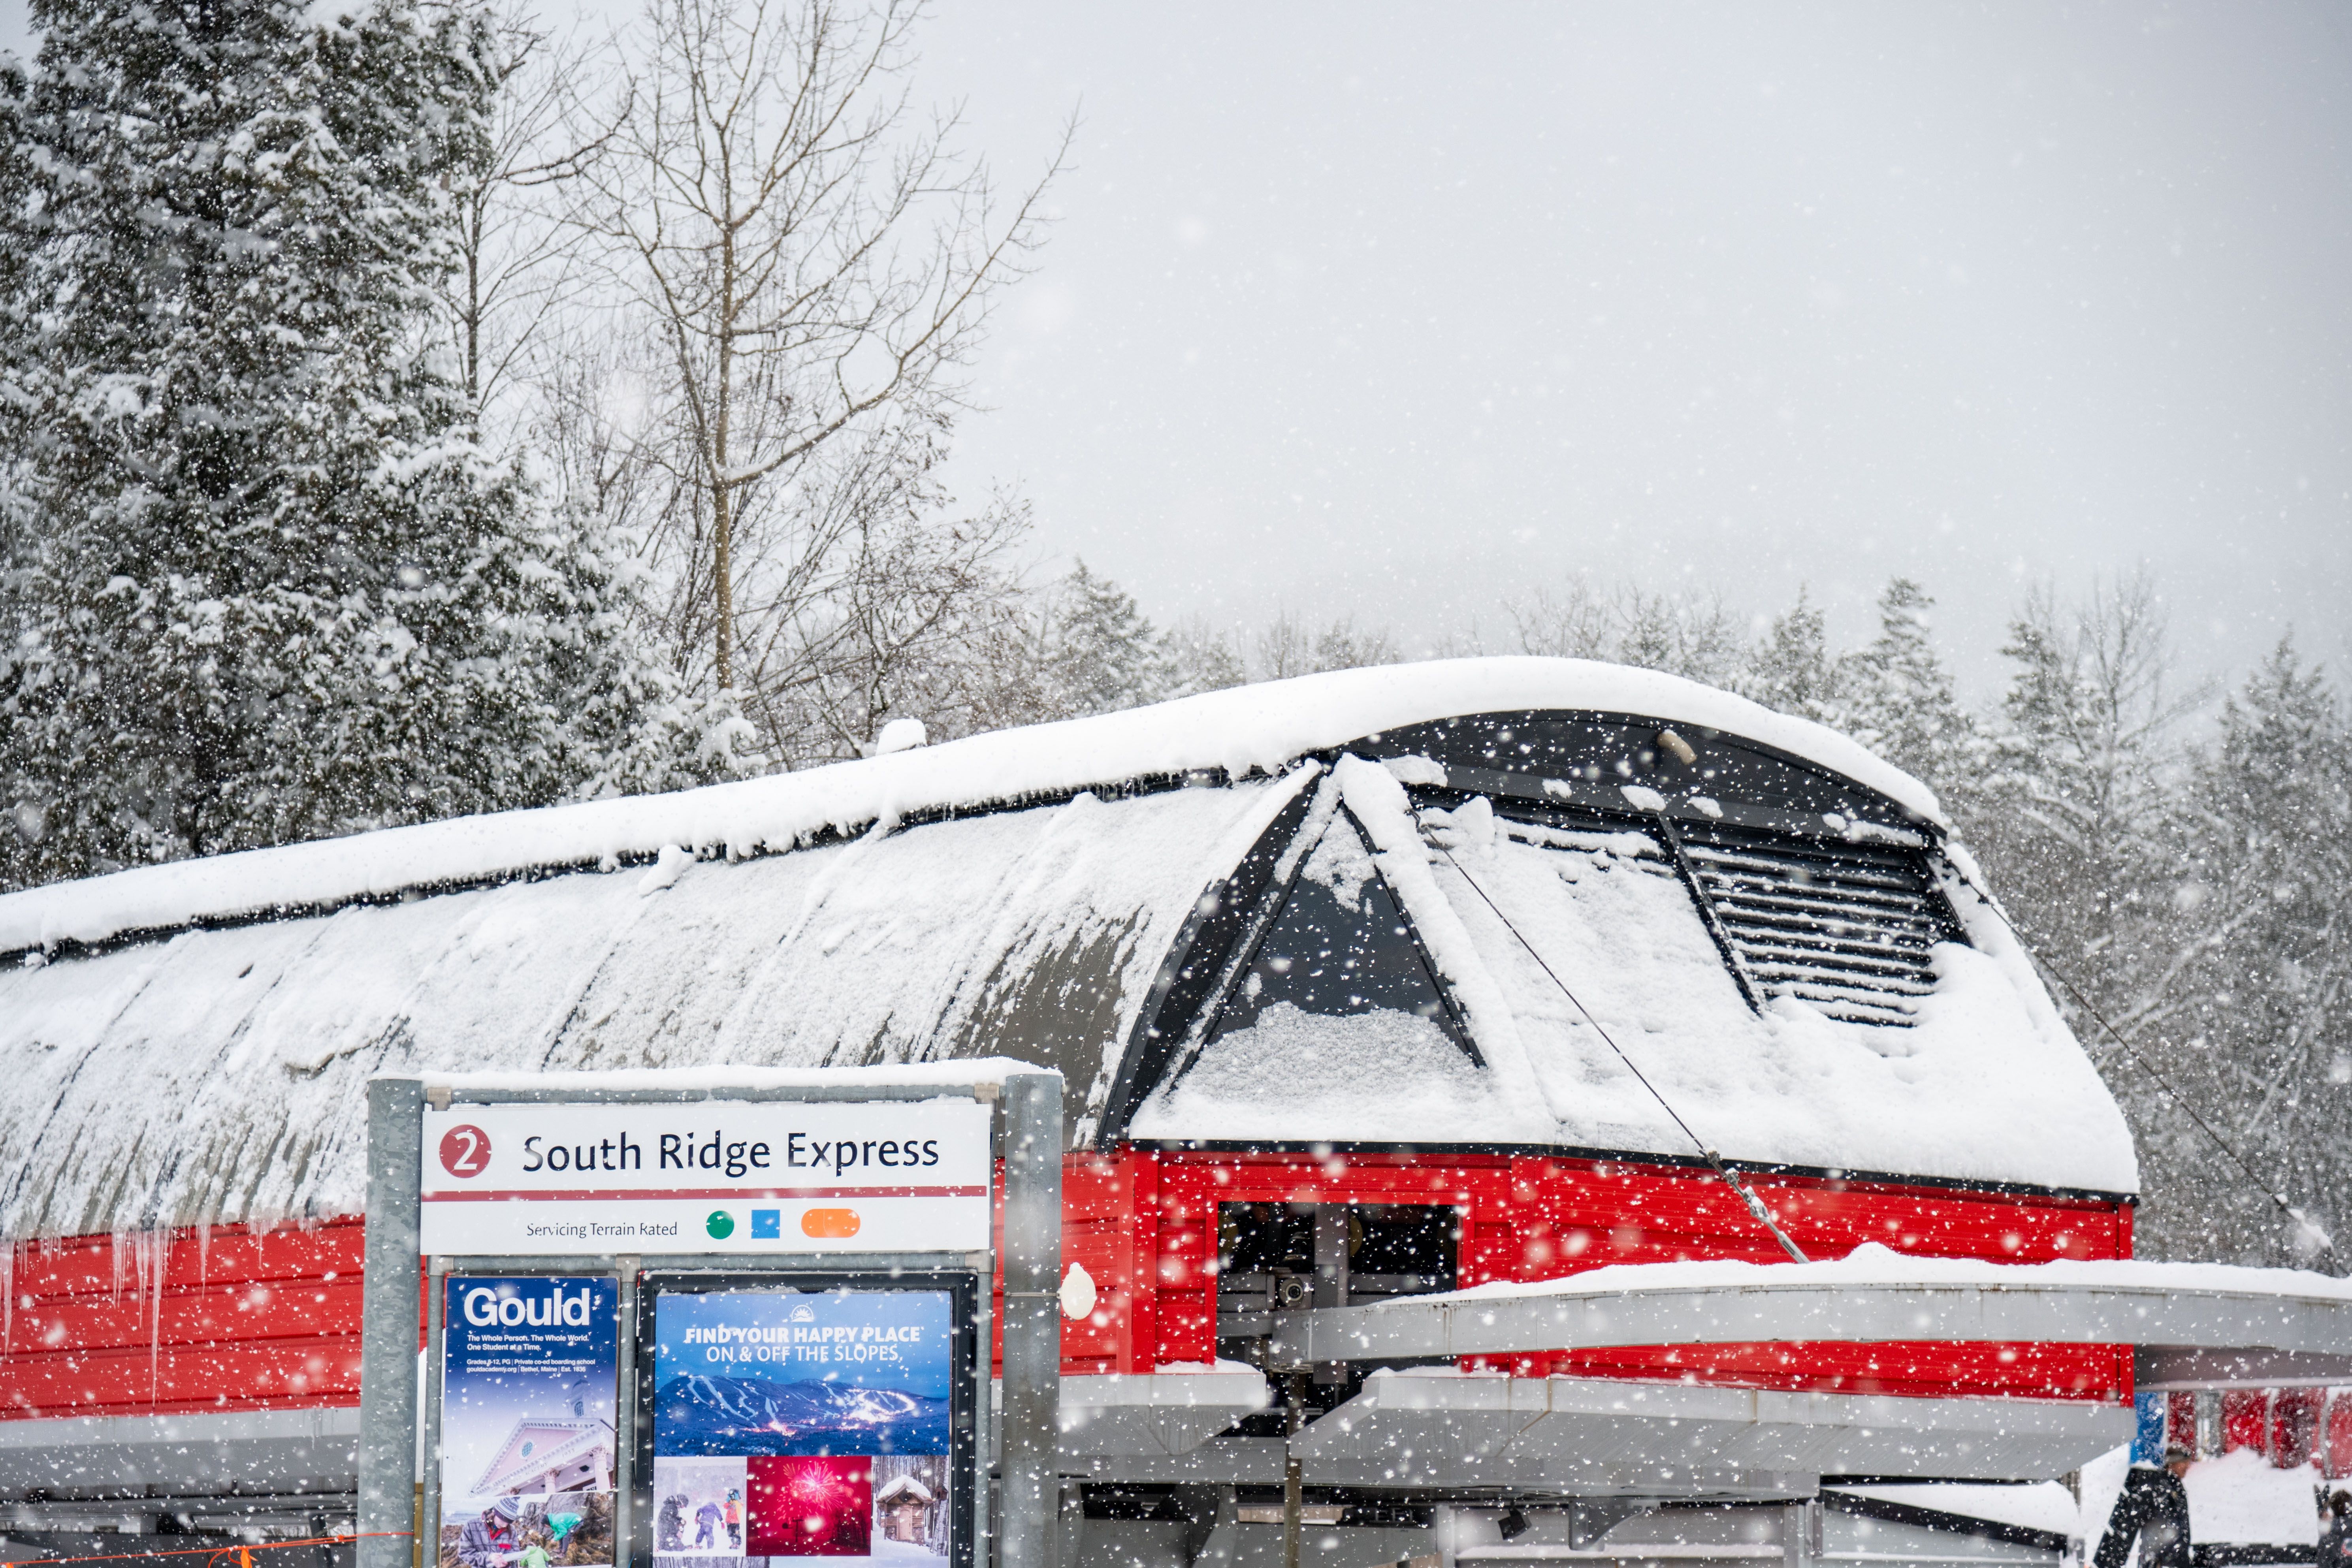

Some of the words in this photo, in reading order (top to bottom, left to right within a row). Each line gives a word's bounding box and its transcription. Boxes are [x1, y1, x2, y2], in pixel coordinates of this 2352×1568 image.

[449, 1131, 478, 1170] 2
[523, 1131, 641, 1171] South
[659, 1130, 770, 1178] Ridge
[788, 1132, 939, 1178] Express
[527, 1222, 587, 1239] Servicing
[590, 1222, 635, 1235] Terrain
[640, 1222, 677, 1235] Rated
[464, 1288, 590, 1326] Gould
[685, 1328, 731, 1343] FIND
[736, 1328, 789, 1343] YOUR
[794, 1327, 859, 1342] HAPPY
[862, 1327, 920, 1342] PLACE
[706, 1346, 734, 1362] ON
[739, 1346, 752, 1362] &
[757, 1346, 790, 1362] OFF
[795, 1346, 829, 1362] THE
[834, 1345, 898, 1361] SLOPES
